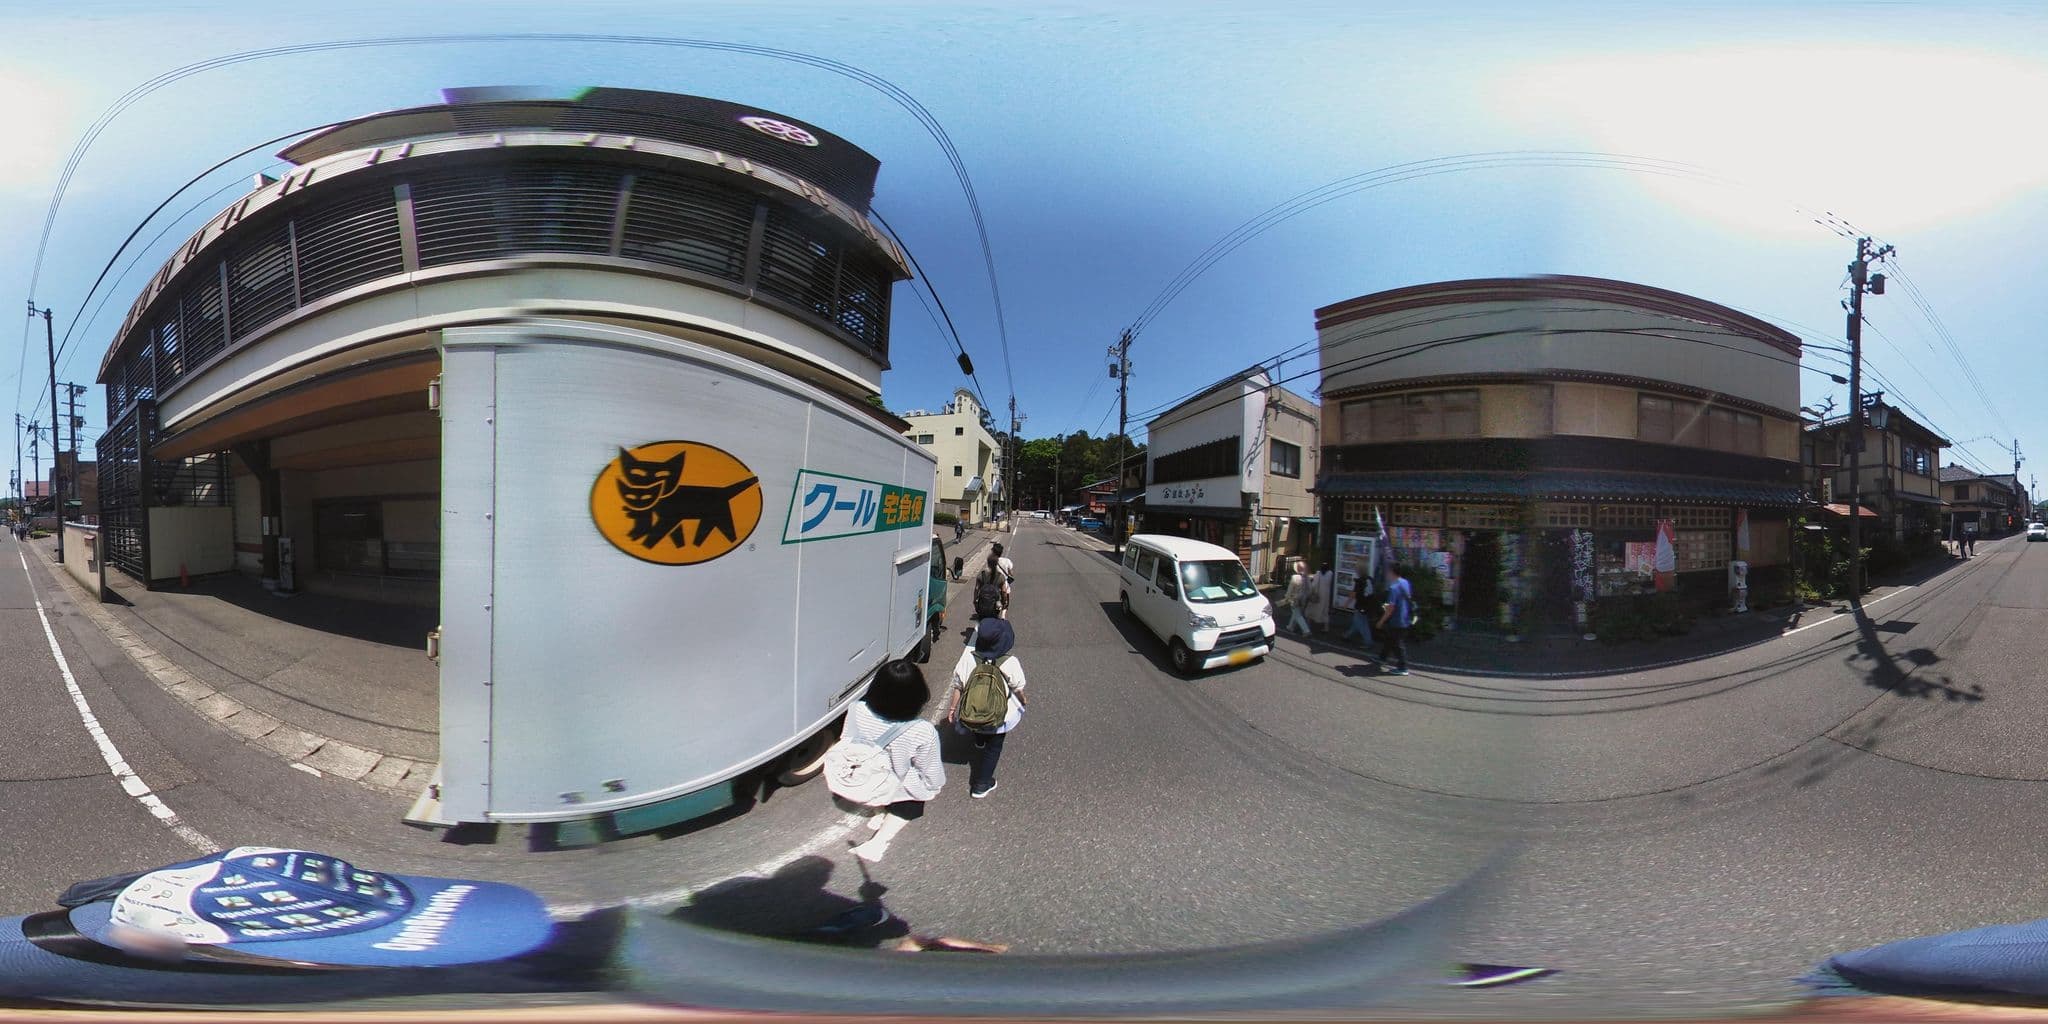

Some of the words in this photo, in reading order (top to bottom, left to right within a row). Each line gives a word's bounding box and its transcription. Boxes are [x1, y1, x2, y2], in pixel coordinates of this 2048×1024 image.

[802, 485, 876, 532] クール
[883, 493, 923, 524] 宅急便
[240, 909, 388, 936] OpenStreetMa
[373, 885, 480, 950] OpenStreetMap
